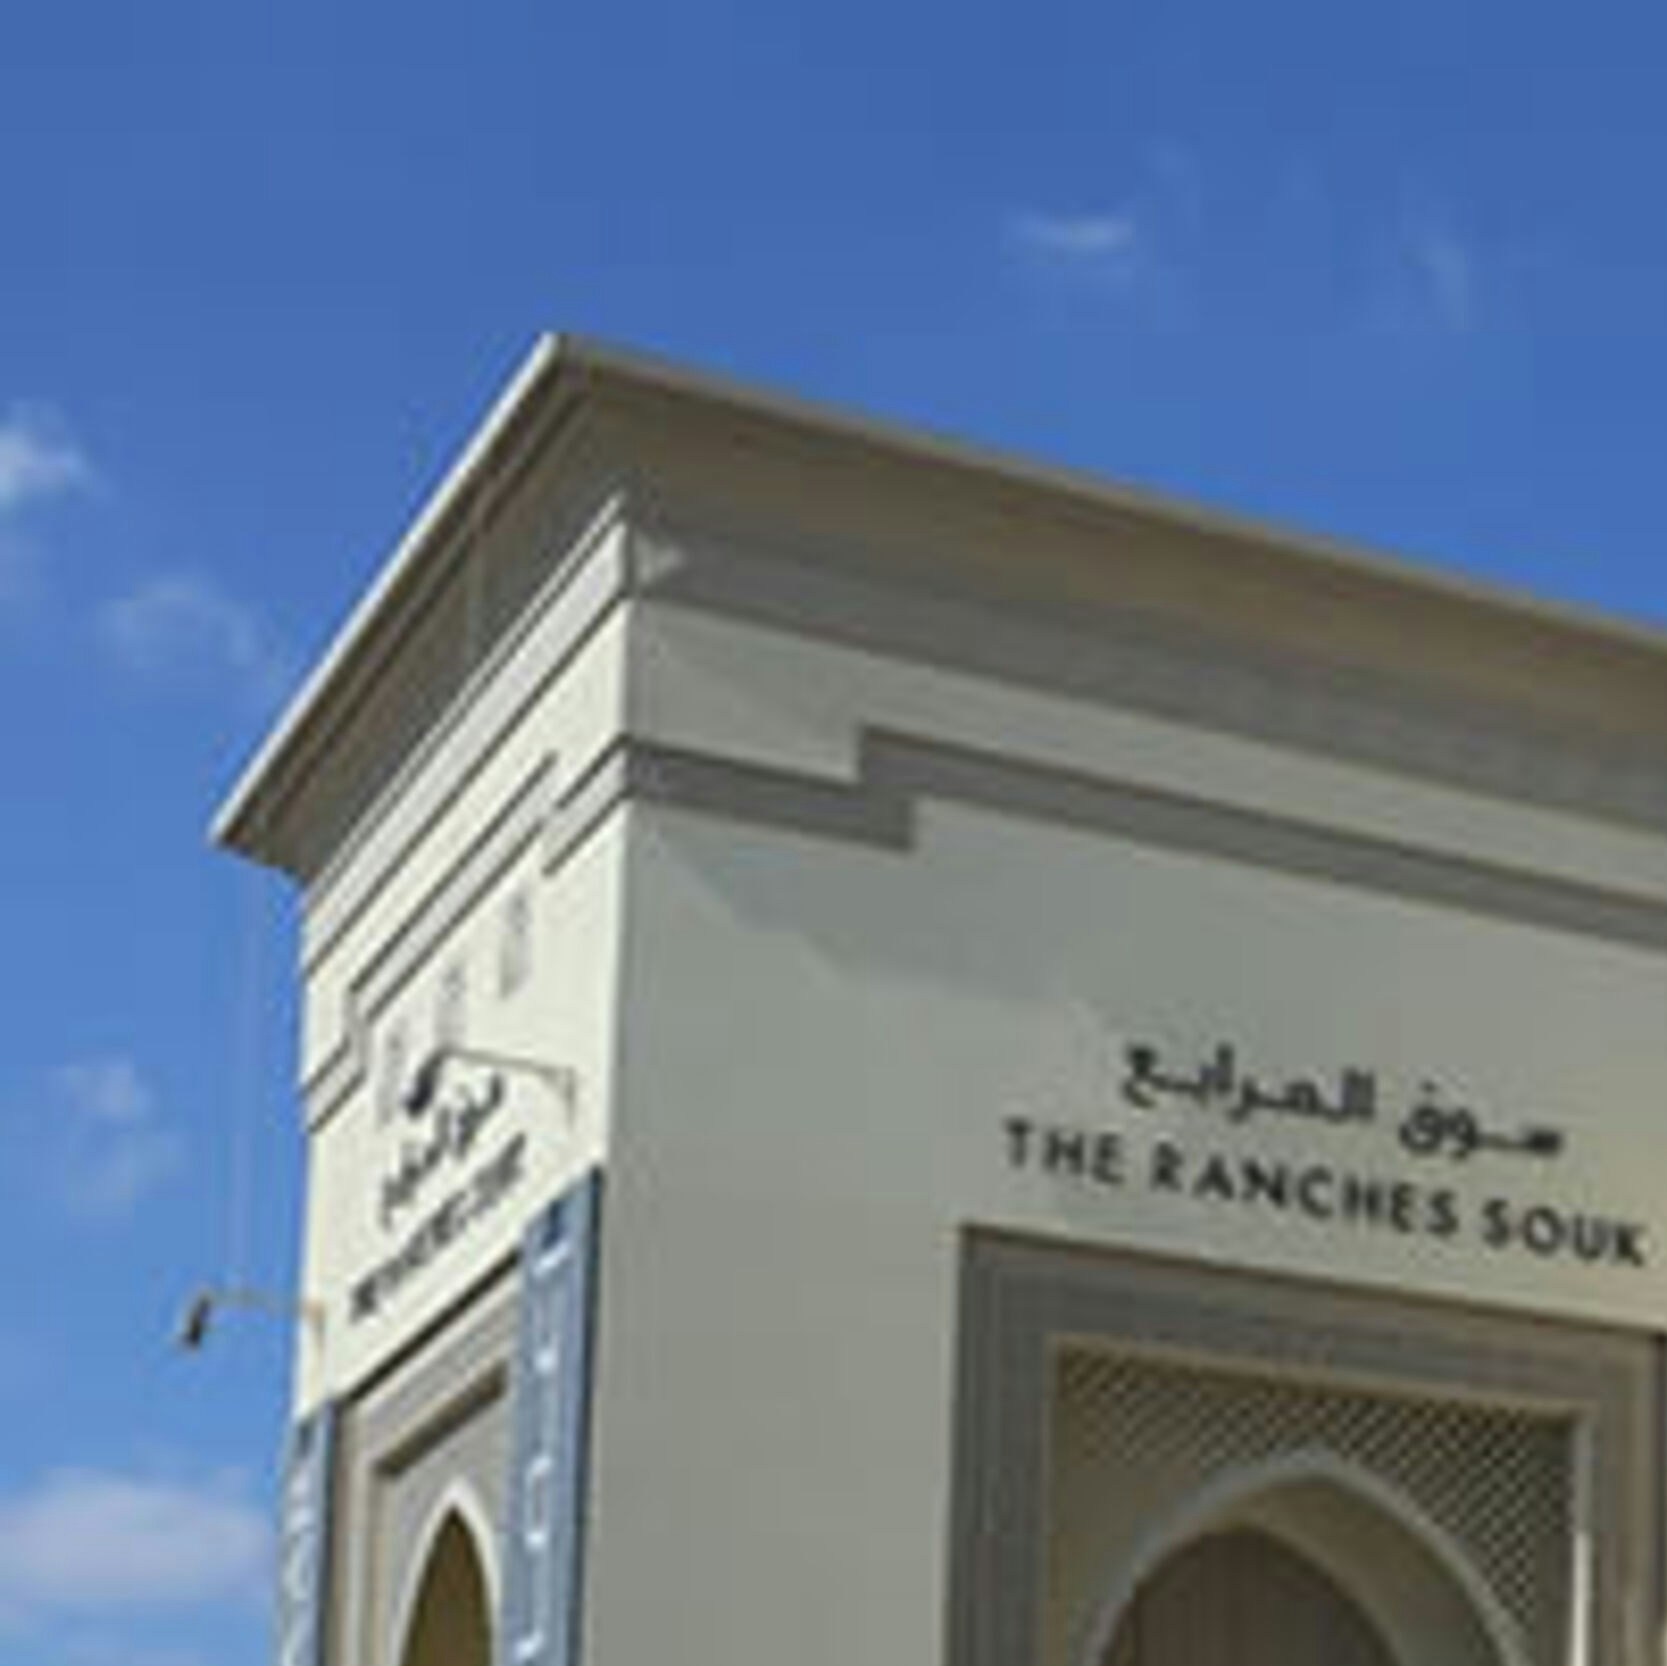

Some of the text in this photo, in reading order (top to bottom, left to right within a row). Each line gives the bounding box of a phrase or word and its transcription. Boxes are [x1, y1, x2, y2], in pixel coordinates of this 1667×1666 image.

[1003, 1115, 1645, 1268] THE RANCHES SOUK
